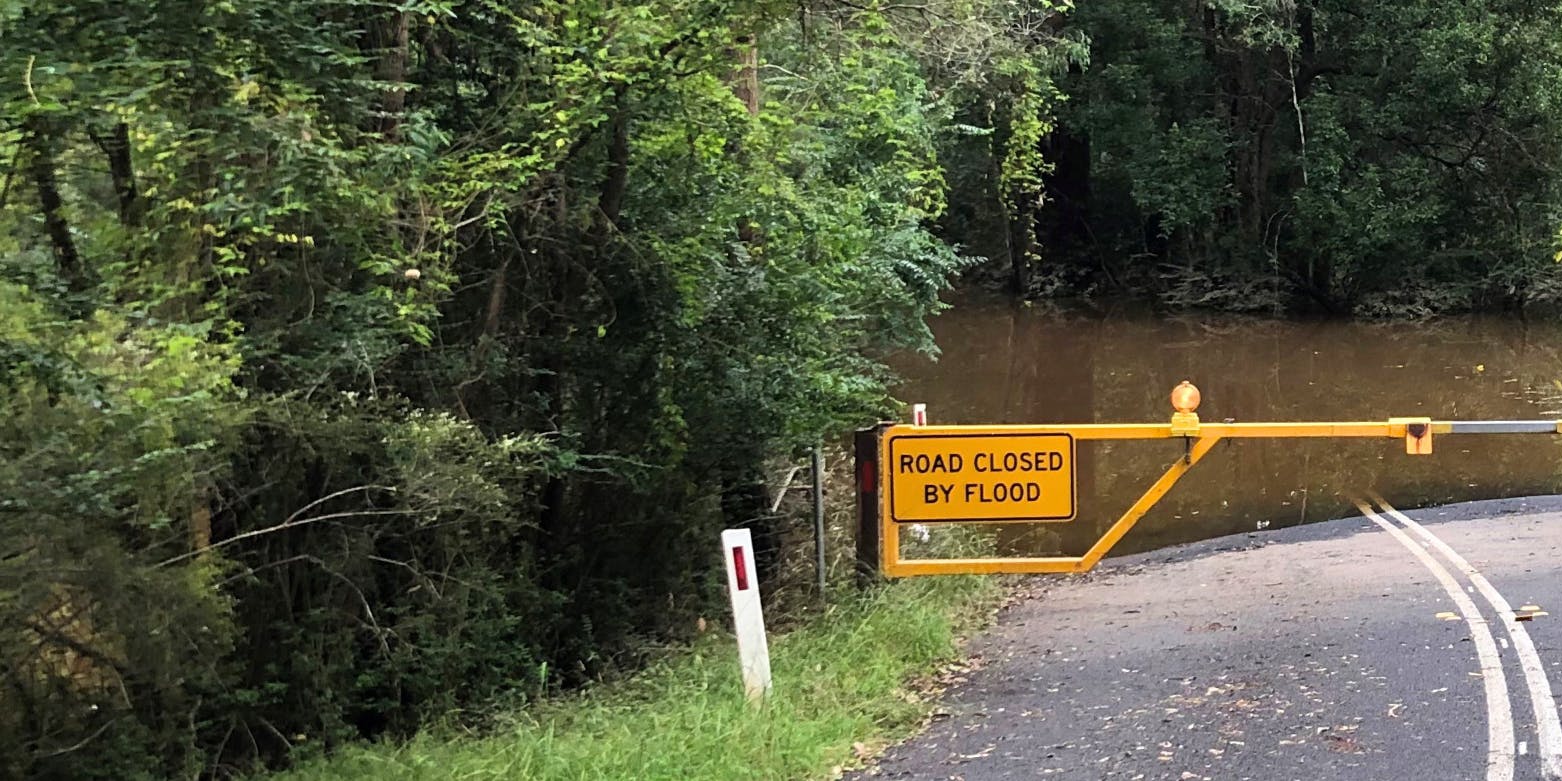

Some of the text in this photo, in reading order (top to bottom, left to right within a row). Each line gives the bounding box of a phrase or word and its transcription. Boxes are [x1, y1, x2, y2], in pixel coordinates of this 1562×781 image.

[900, 452, 1063, 474] ROAD CLOSED
[924, 483, 1041, 504] BY FLOOD
